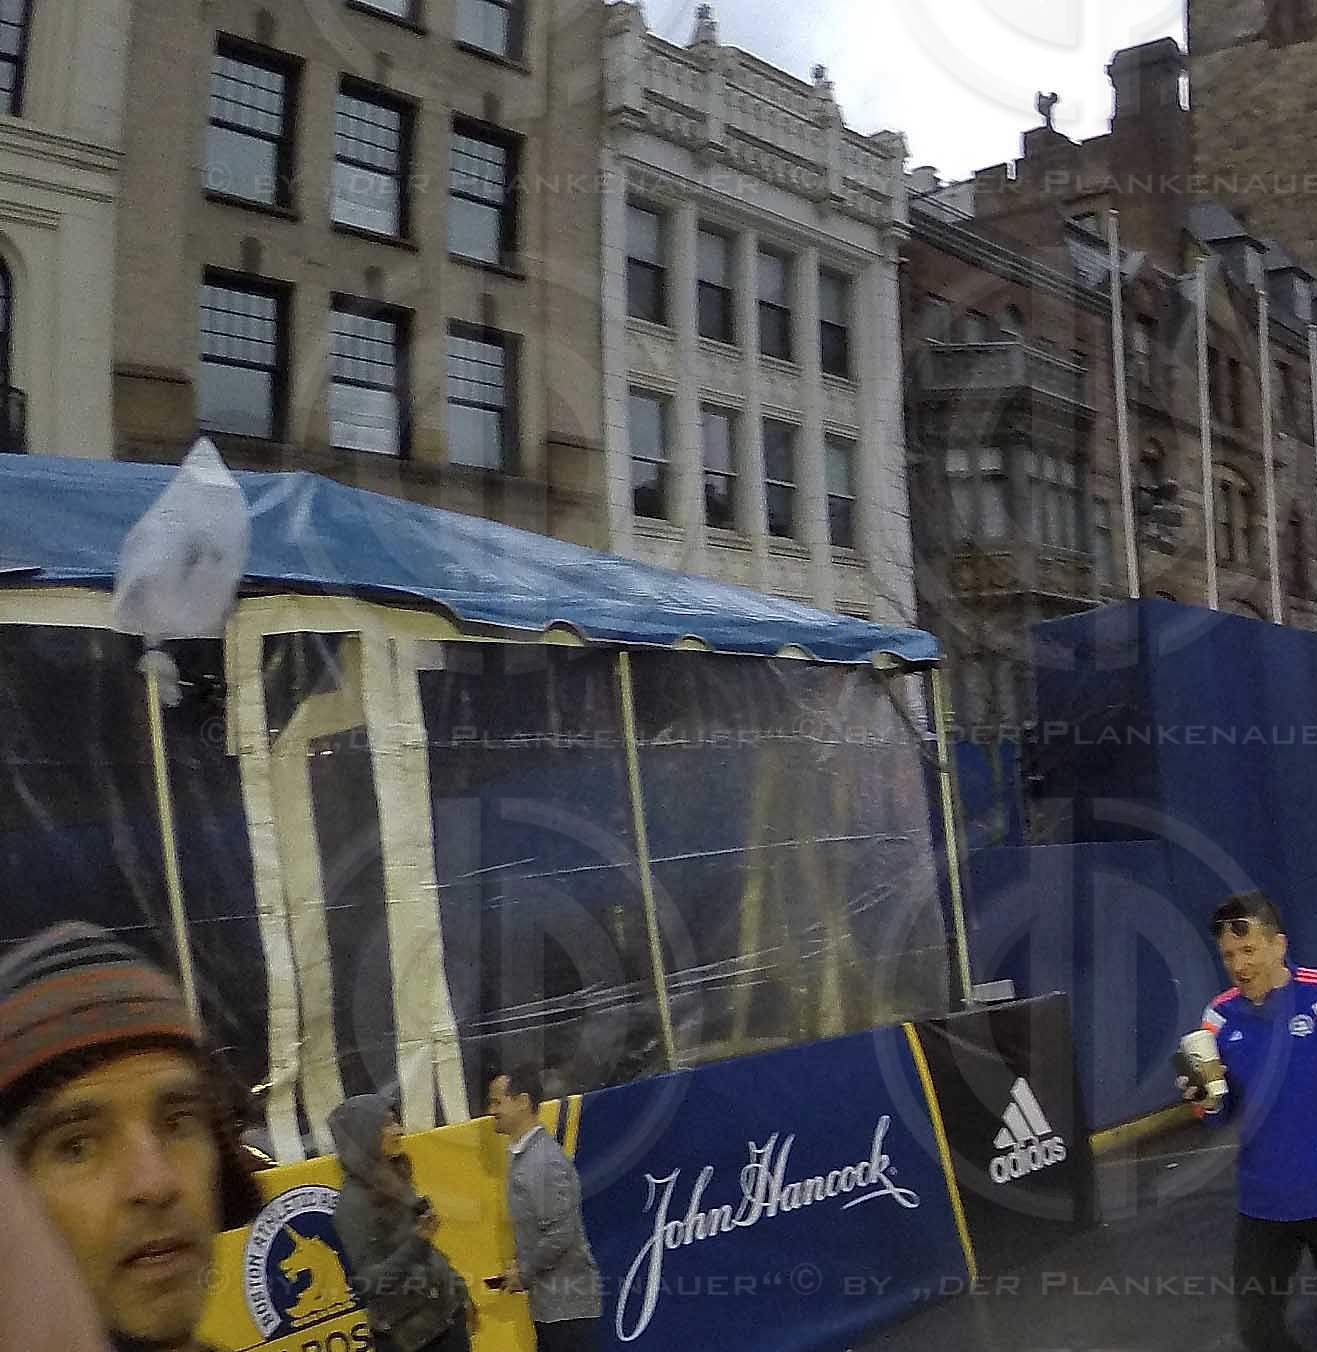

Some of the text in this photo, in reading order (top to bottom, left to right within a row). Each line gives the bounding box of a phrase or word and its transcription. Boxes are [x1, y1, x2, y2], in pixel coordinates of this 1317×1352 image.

[616, 1115, 920, 1341] John Hancock
[988, 1135, 1067, 1184] adidas
